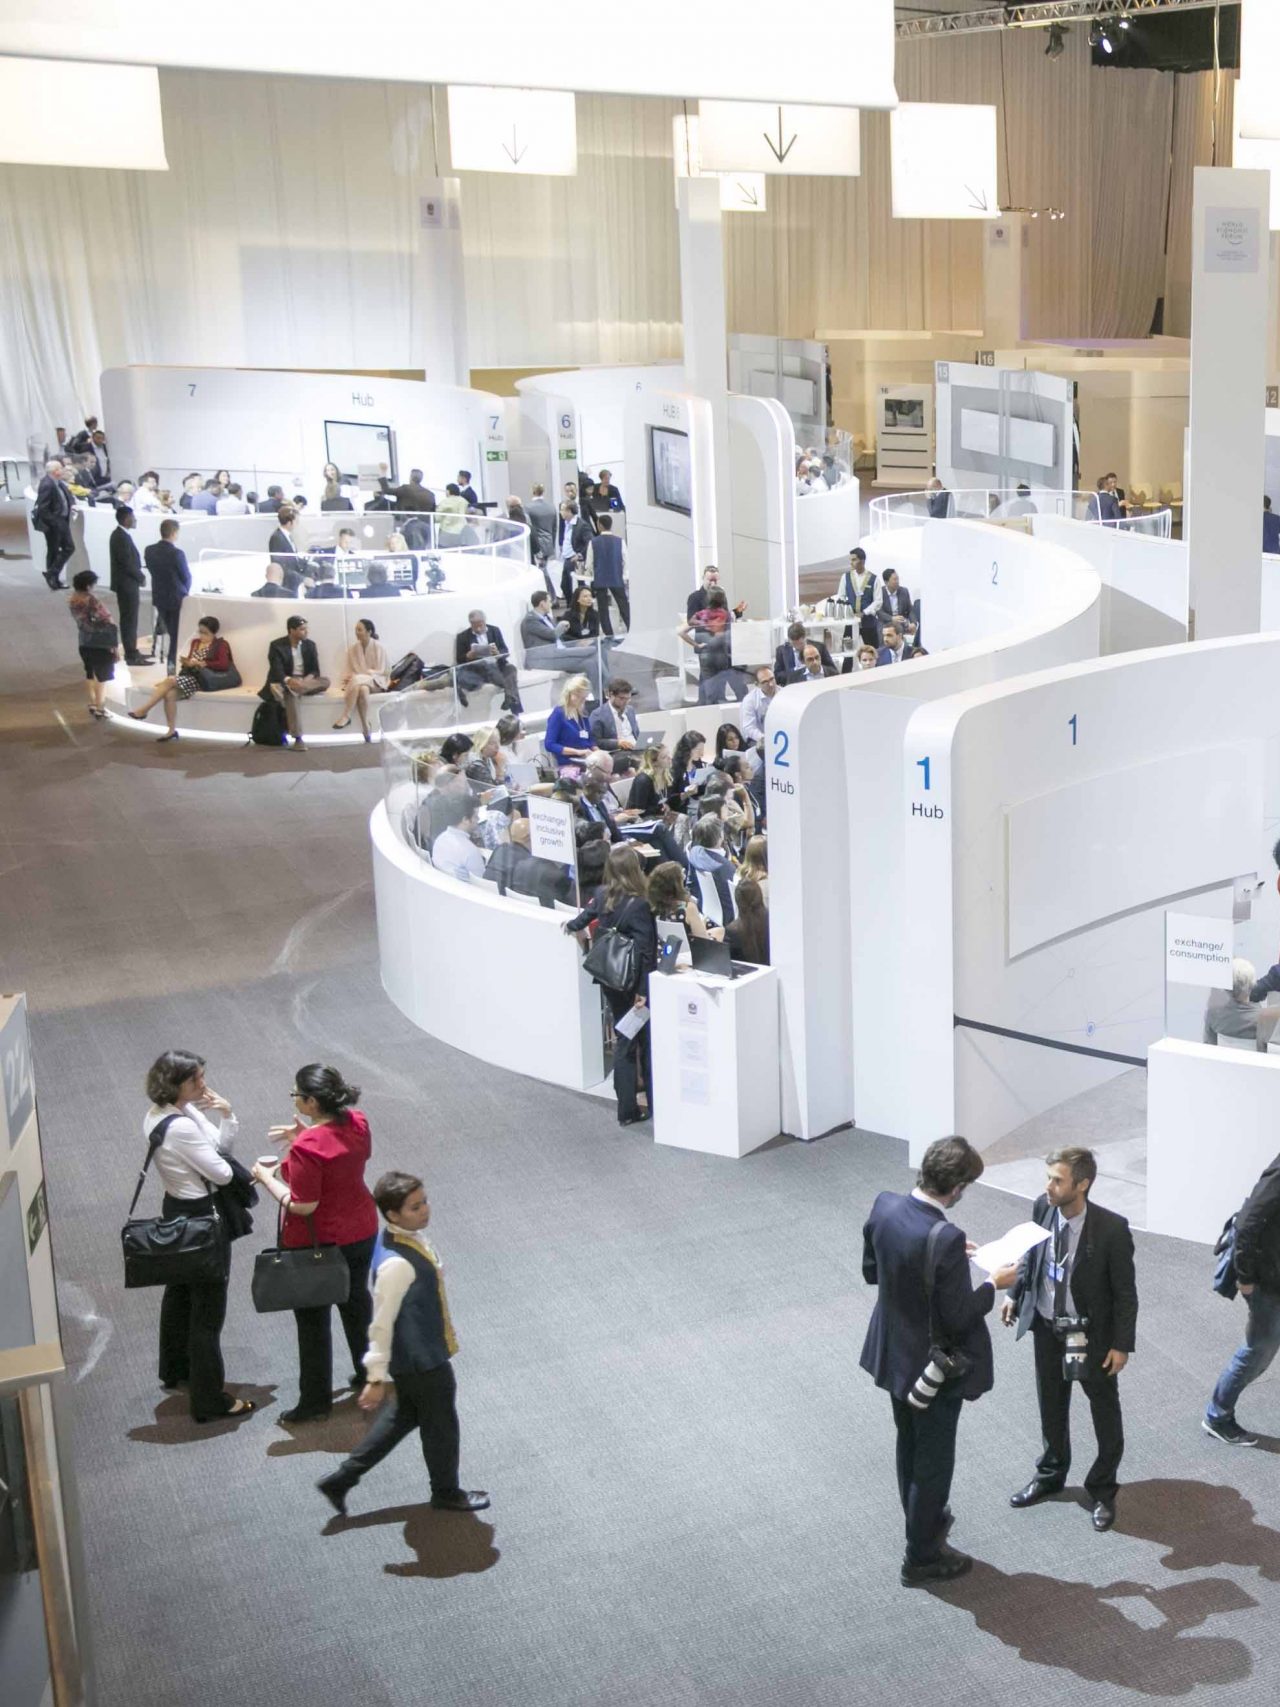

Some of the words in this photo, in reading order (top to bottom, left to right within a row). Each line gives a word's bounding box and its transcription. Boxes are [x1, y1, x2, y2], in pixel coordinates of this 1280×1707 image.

[982, 354, 994, 365] 16
[188, 384, 197, 397] 7
[352, 391, 375, 408] Hub
[488, 415, 500, 430] 7
[561, 414, 572, 429] 6
[991, 560, 999, 586] 2
[1068, 714, 1078, 746] 1
[773, 730, 790, 767] 2
[916, 756, 930, 790] 1
[770, 776, 795, 795] Hub
[911, 802, 945, 819] Hub
[532, 811, 567, 827] exchange/
[536, 824, 565, 838] inclusive
[540, 836, 564, 848] growth
[1174, 938, 1225, 952] exchange/
[1169, 948, 1230, 963] consumption
